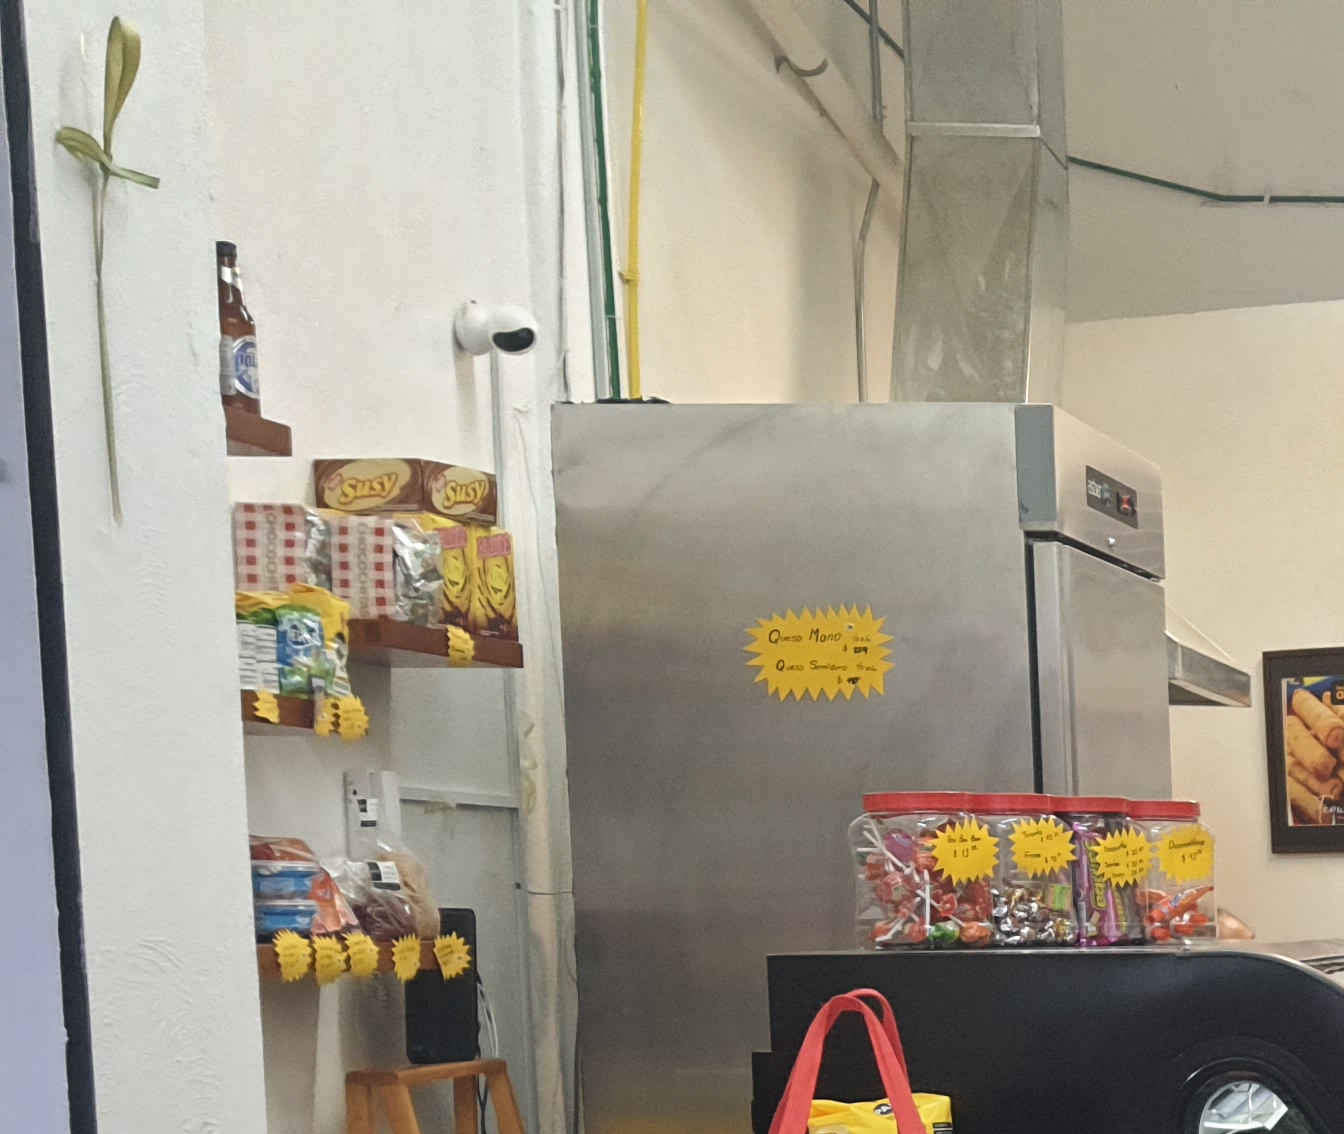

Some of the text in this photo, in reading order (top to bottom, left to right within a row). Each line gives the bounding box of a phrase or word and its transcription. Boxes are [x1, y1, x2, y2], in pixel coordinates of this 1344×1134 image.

[338, 472, 398, 504] Susy
[443, 480, 487, 509] Susy
[768, 629, 802, 644] Queso
[776, 659, 804, 671] Queso
